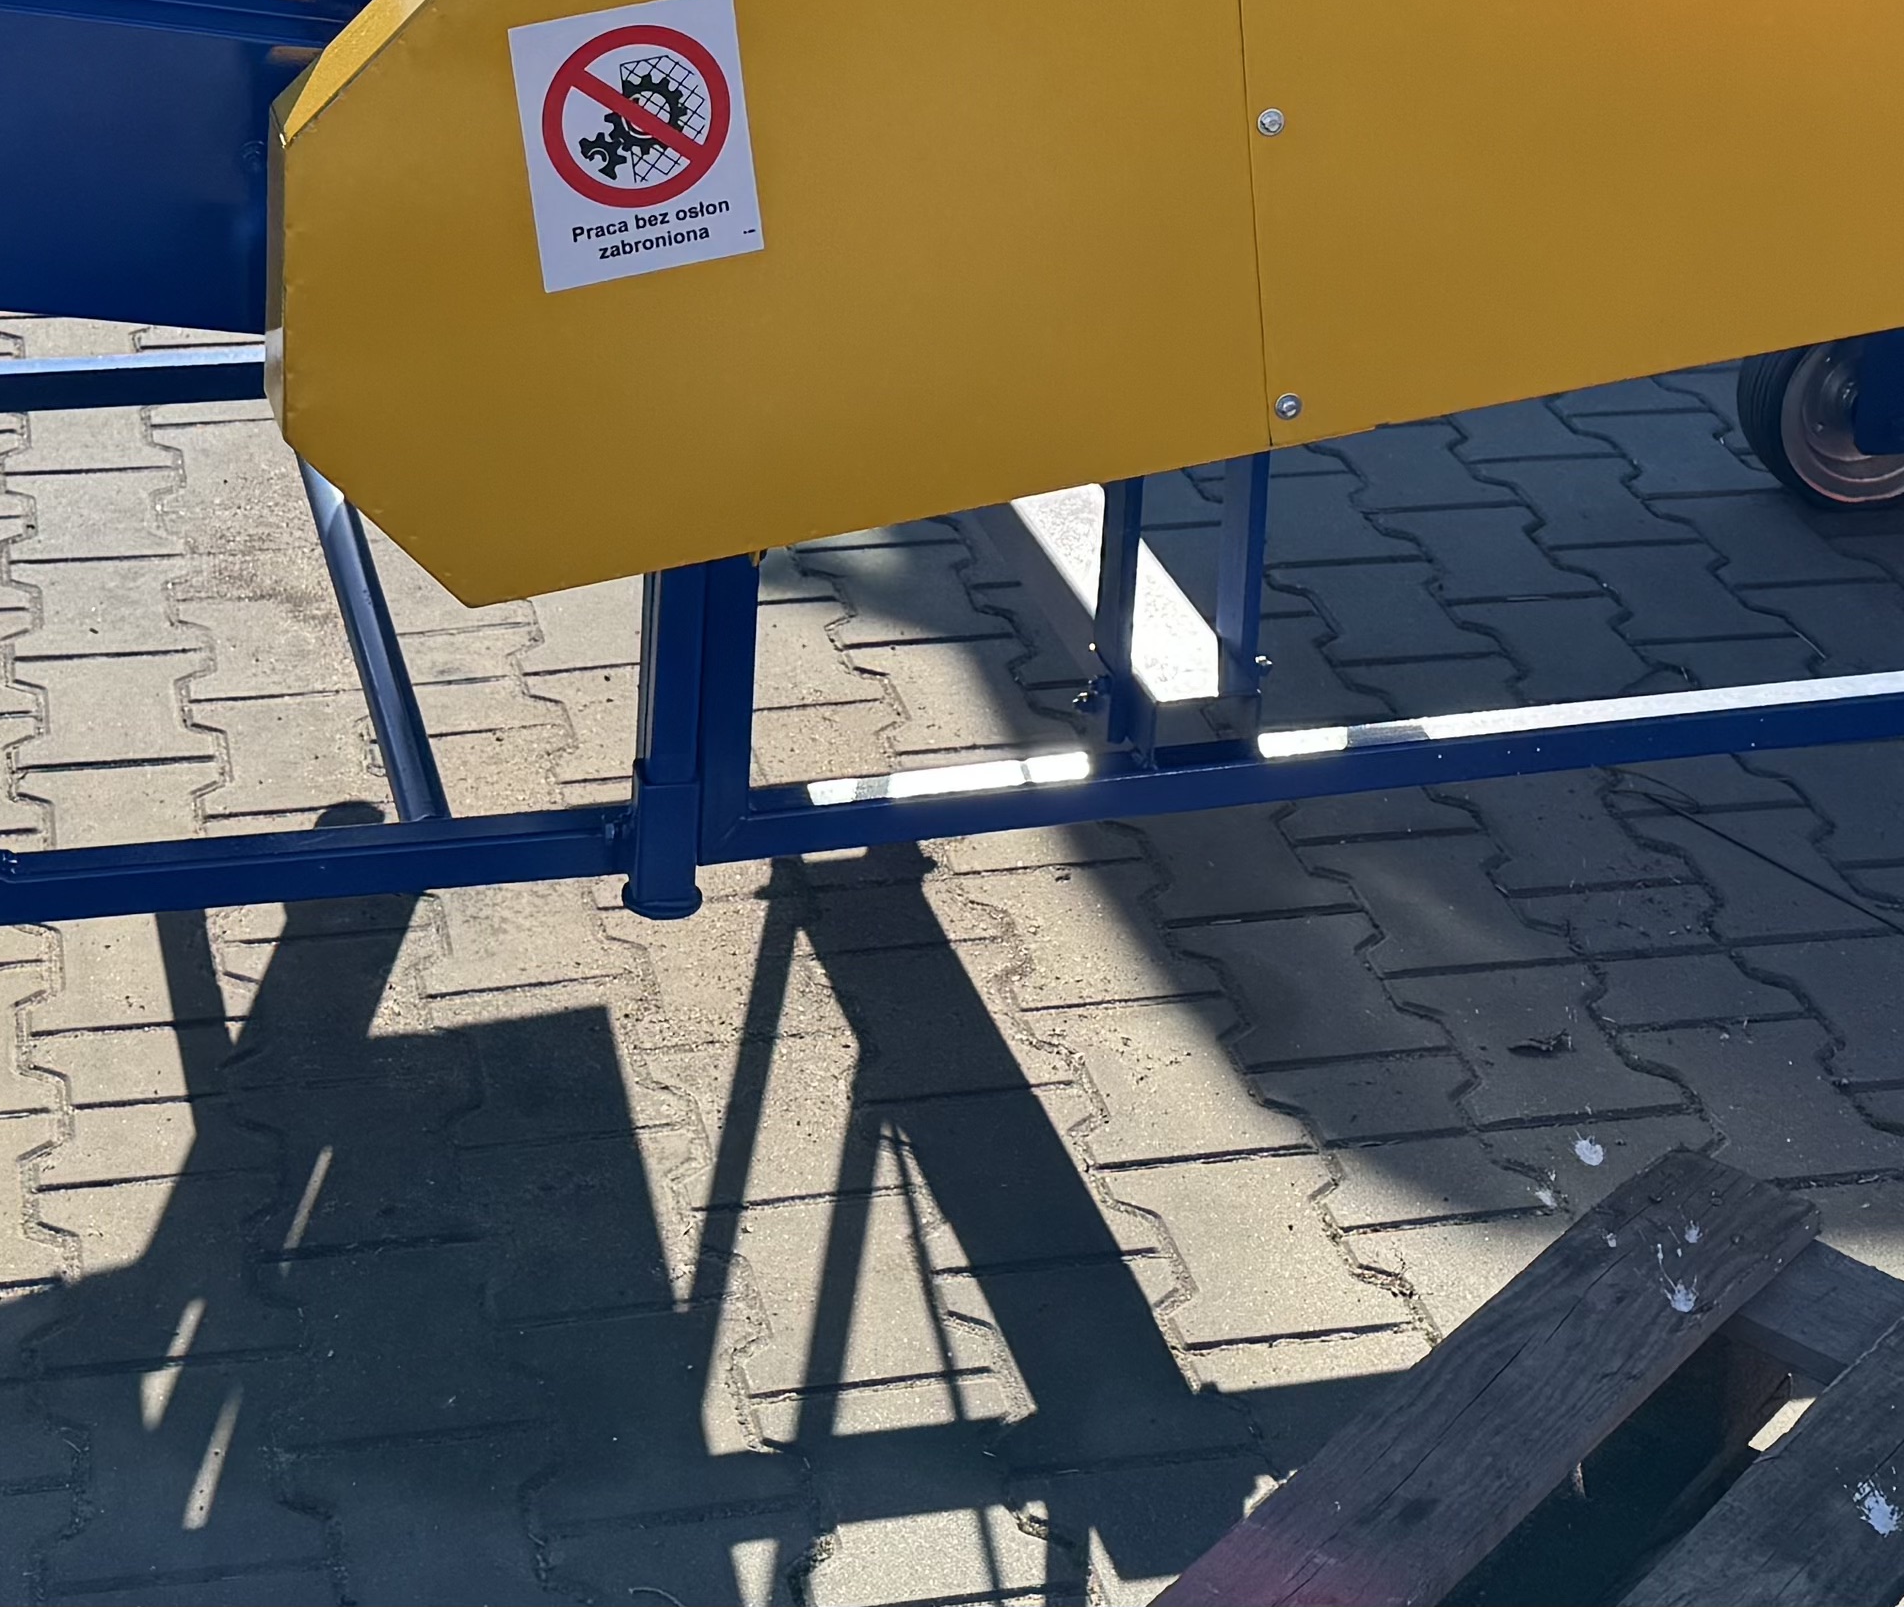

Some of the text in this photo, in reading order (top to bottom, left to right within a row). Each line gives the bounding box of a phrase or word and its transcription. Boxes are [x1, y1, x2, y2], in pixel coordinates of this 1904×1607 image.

[572, 200, 730, 243] Praca bez osłon
[598, 226, 710, 260] zabroniona
